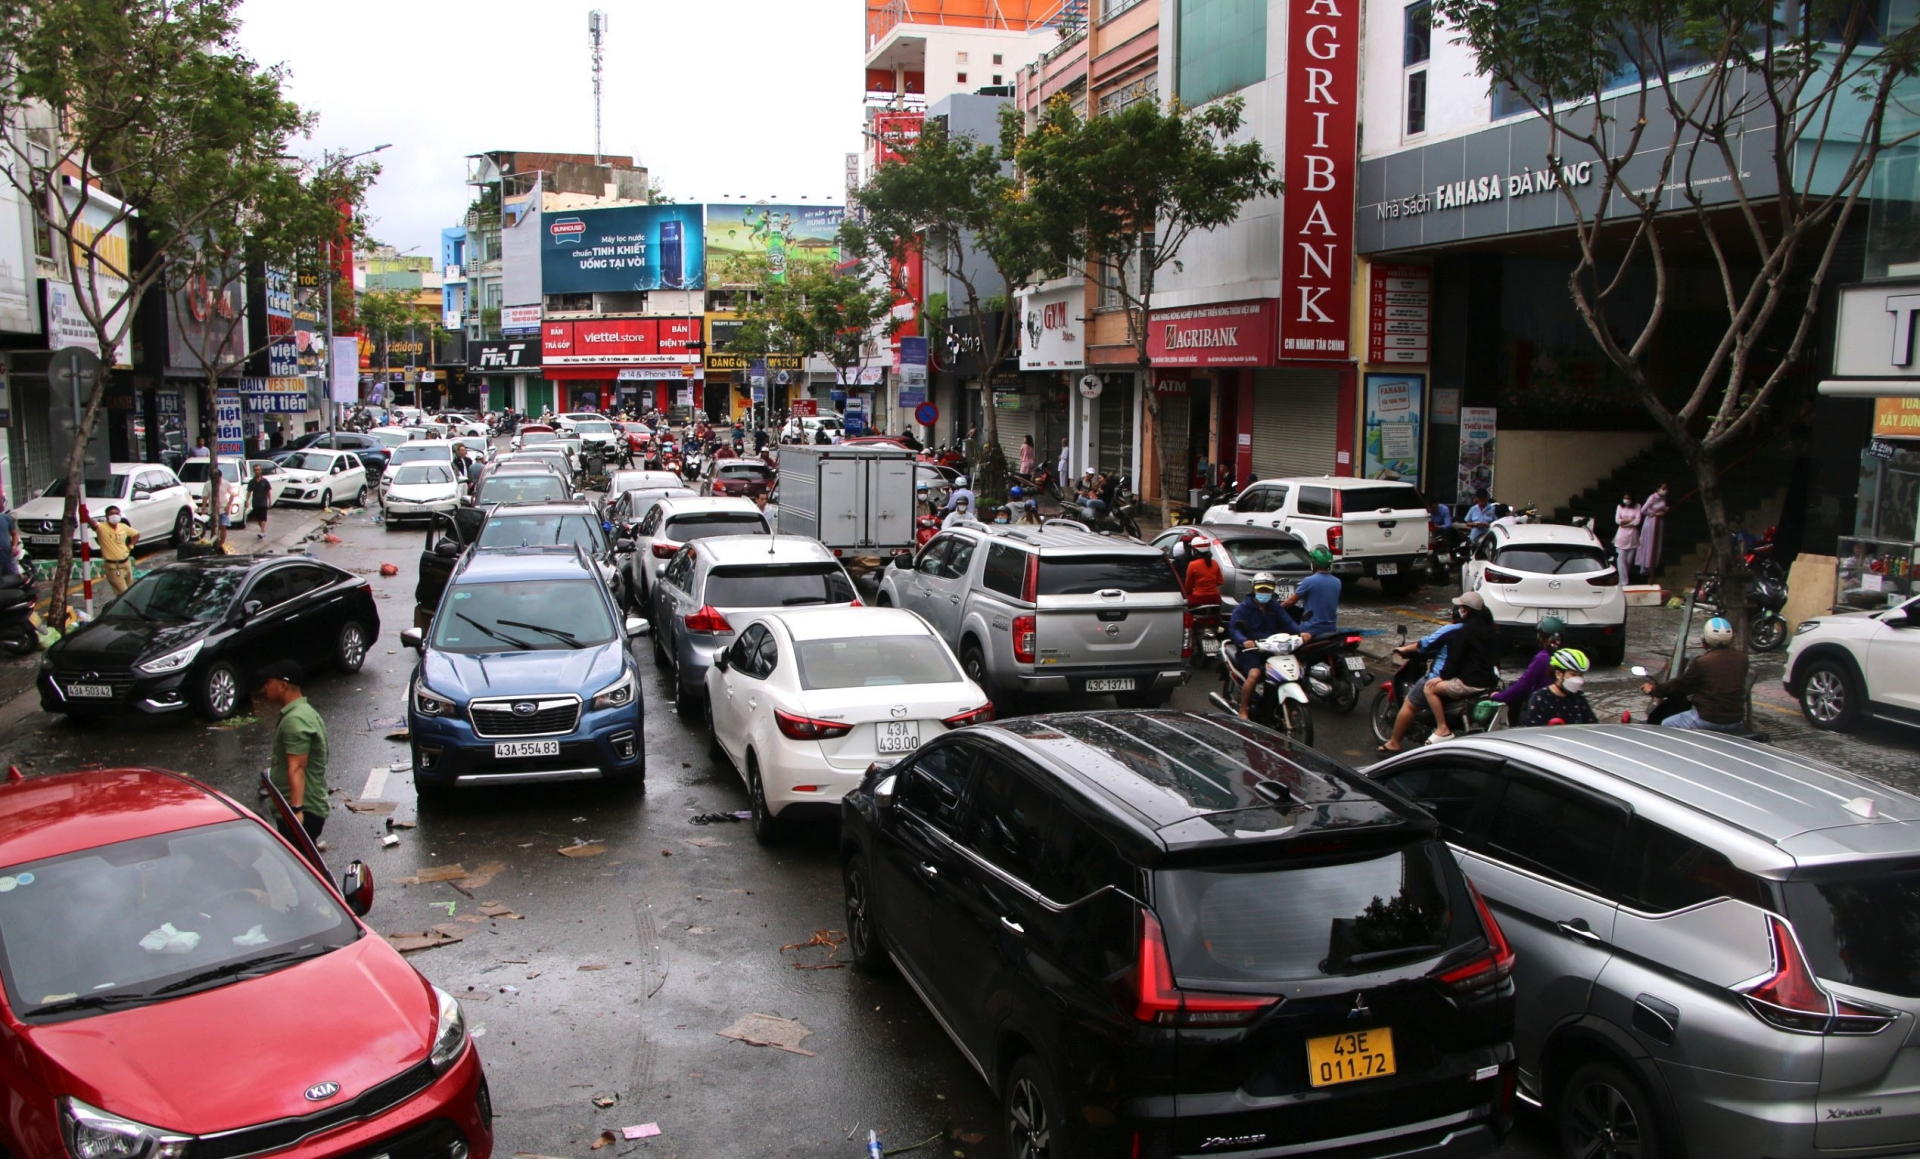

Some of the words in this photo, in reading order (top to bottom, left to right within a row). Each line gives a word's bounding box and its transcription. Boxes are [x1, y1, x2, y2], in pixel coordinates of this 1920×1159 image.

[1377, 200, 1400, 220] Nhà
[1402, 194, 1431, 216] Sách
[1436, 174, 1501, 210] FAHASA
[1508, 167, 1533, 197] ĐÀ
[553, 225, 583, 233] SUNHOUSE
[602, 235, 616, 244] Máy
[616, 234, 626, 243] lọc
[628, 233, 645, 242] nước
[617, 242, 646, 256] KHIẾT
[580, 257, 607, 269] UỐNG
[609, 257, 625, 270] TẠI
[627, 256, 645, 267] VÒI
[299, 274, 318, 285] TÓC
[1044, 301, 1067, 329] GYM
[550, 326, 564, 336] BÁN
[671, 323, 688, 333] BÁN
[544, 340, 557, 349] TRẢ
[557, 339, 571, 349] GÓP
[584, 332, 620, 343] viettel
[621, 333, 645, 342] store
[659, 338, 677, 348] ĐIỆN
[1176, 327, 1239, 348] AGRIBANK
[1284, 338, 1295, 350] CHI
[1295, 336, 1315, 350] NHÁNH
[1316, 337, 1327, 350] TÂN
[1327, 338, 1345, 351] CHÍNH
[270, 343, 297, 361] việt
[271, 359, 298, 376] tiến
[636, 370, 642, 378] &
[288, 379, 305, 391] TON
[1158, 380, 1187, 392] ATM
[1380, 386, 1407, 395] FAHASA
[249, 394, 276, 413] việt
[280, 393, 307, 411] tiến
[1463, 422, 1482, 430] THIẾU
[1880, 412, 1899, 427] XÂY
[1901, 413, 1920, 430] DỰN
[1870, 441, 1893, 455] K298
[68, 686, 111, 697] 43A-503.42
[1087, 679, 1134, 691] 43C-137.11
[887, 723, 909, 736] 43A
[497, 741, 558, 757] 43A-554.83
[879, 736, 919, 751] 439.00
[1333, 1032, 1369, 1056] 43E
[1320, 1053, 1387, 1083] 011.72
[310, 1082, 338, 1098] KIA
[1827, 1106, 1882, 1119] XPANDER
[1200, 1133, 1266, 1149] XPANDER
